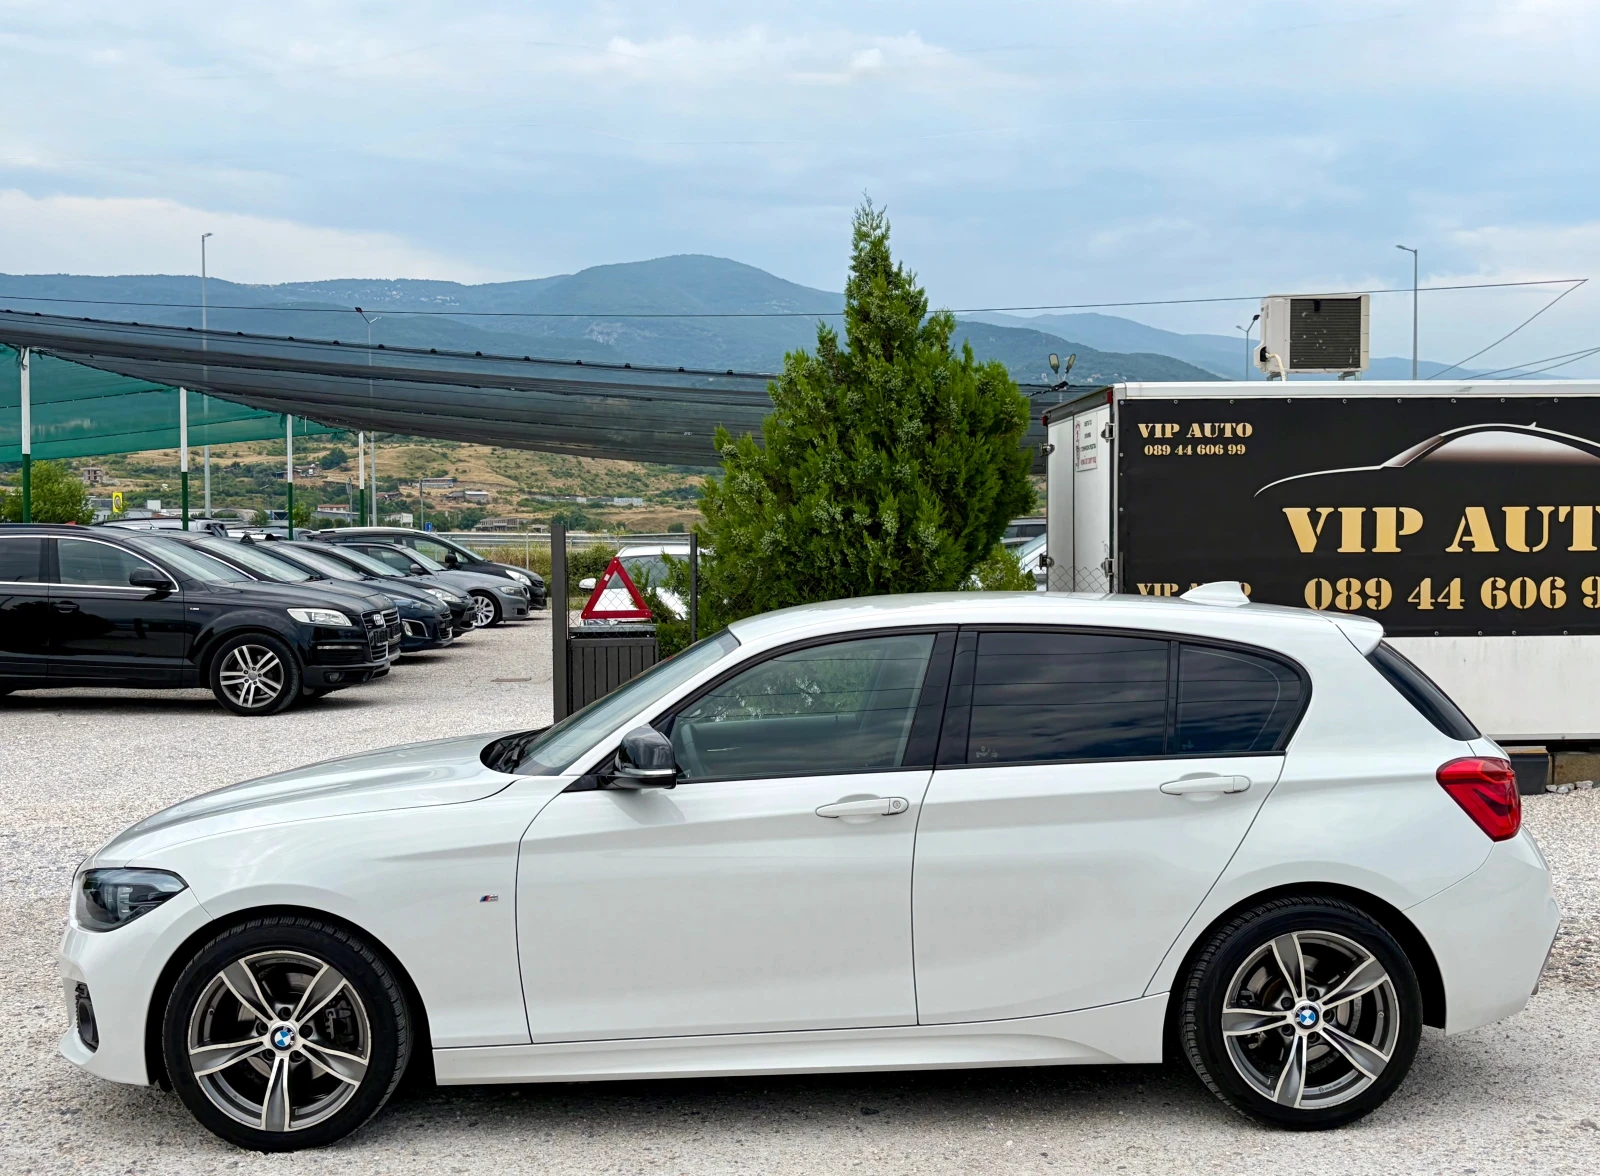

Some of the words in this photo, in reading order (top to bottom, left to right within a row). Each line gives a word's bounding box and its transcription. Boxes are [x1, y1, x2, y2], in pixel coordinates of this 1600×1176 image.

[1138, 423, 1180, 438] VIP
[1186, 422, 1253, 438] AUTO
[1144, 444, 1171, 456] 089
[1174, 444, 1193, 456] 44
[1196, 444, 1224, 455] 606
[1227, 444, 1246, 455] 99
[1282, 507, 1424, 553] VIP
[1137, 583, 1179, 597] VIP
[1304, 577, 1393, 611] 089
[1407, 577, 1465, 610] 44
[1480, 576, 1567, 610] 606
